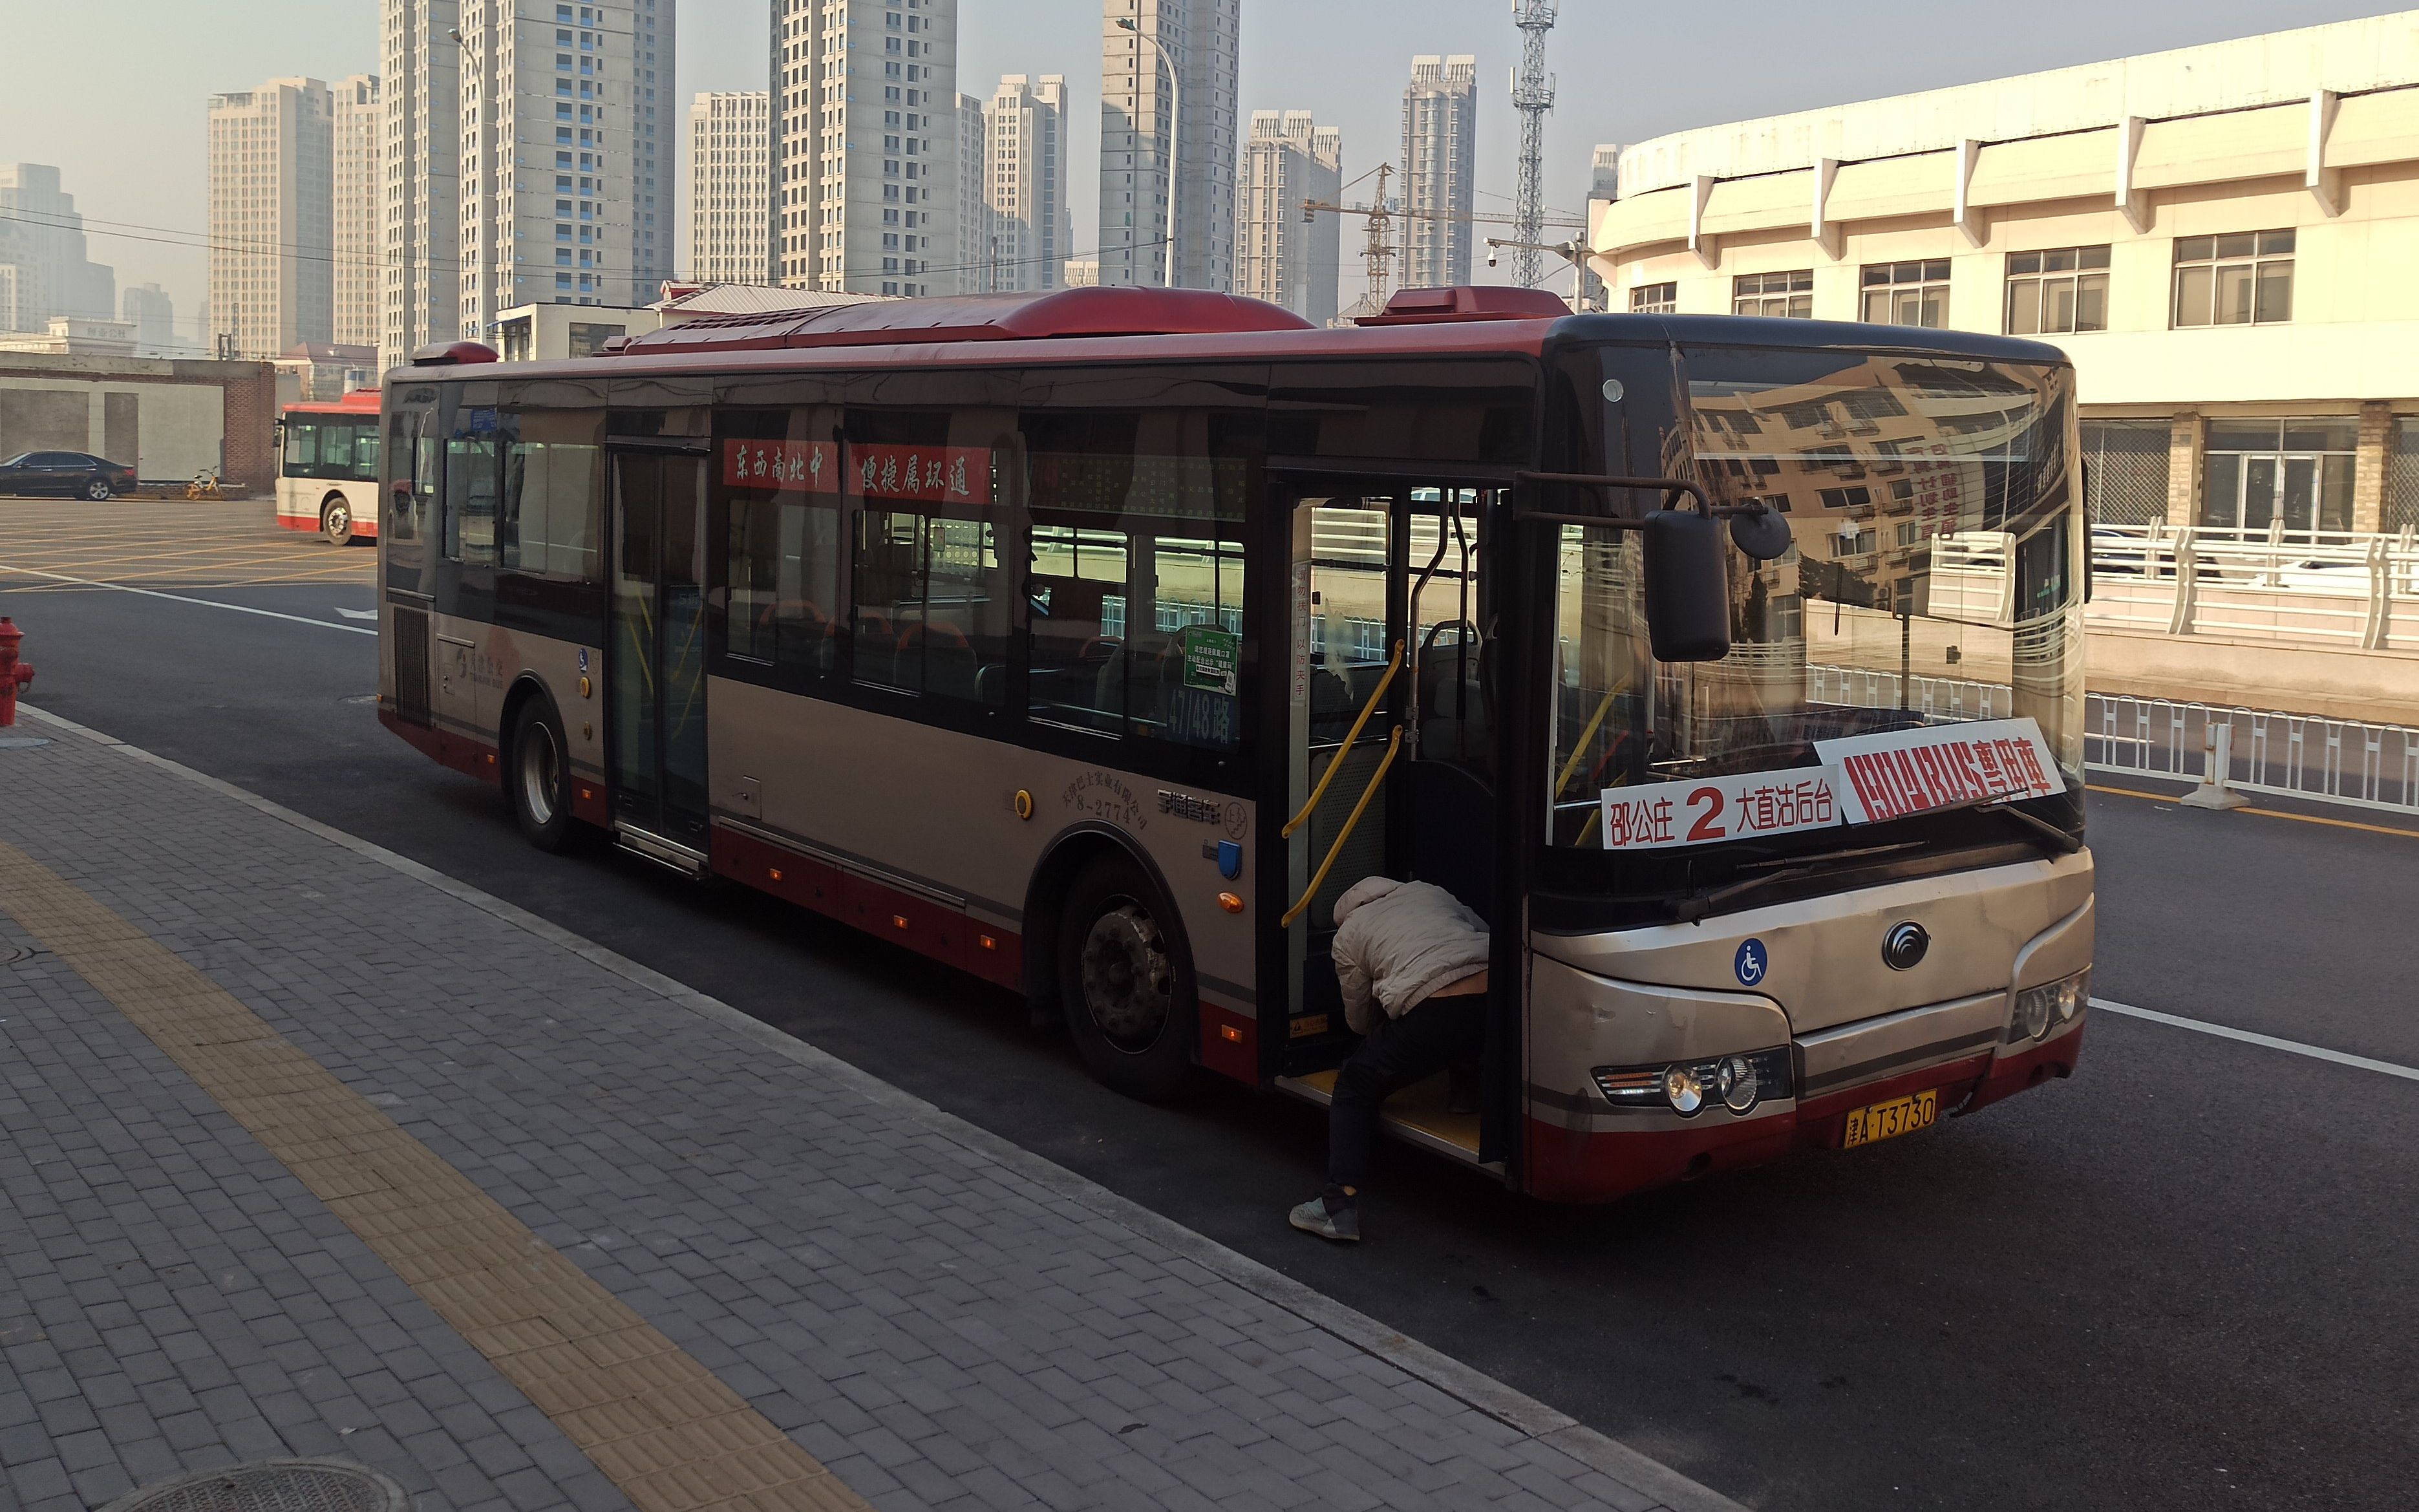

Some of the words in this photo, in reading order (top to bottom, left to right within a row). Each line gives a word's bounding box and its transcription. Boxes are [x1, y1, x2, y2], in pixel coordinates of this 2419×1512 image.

[736, 444, 824, 488] 东西南北中
[1062, 771, 1147, 831] 天津巴士实业有限公司
[1076, 794, 1131, 825] 8-2774
[1157, 788, 1220, 825] 宇通客车
[1610, 796, 1675, 846] 邵公庄
[1686, 787, 1726, 843] 2
[1736, 778, 1833, 833] 大直沽后台
